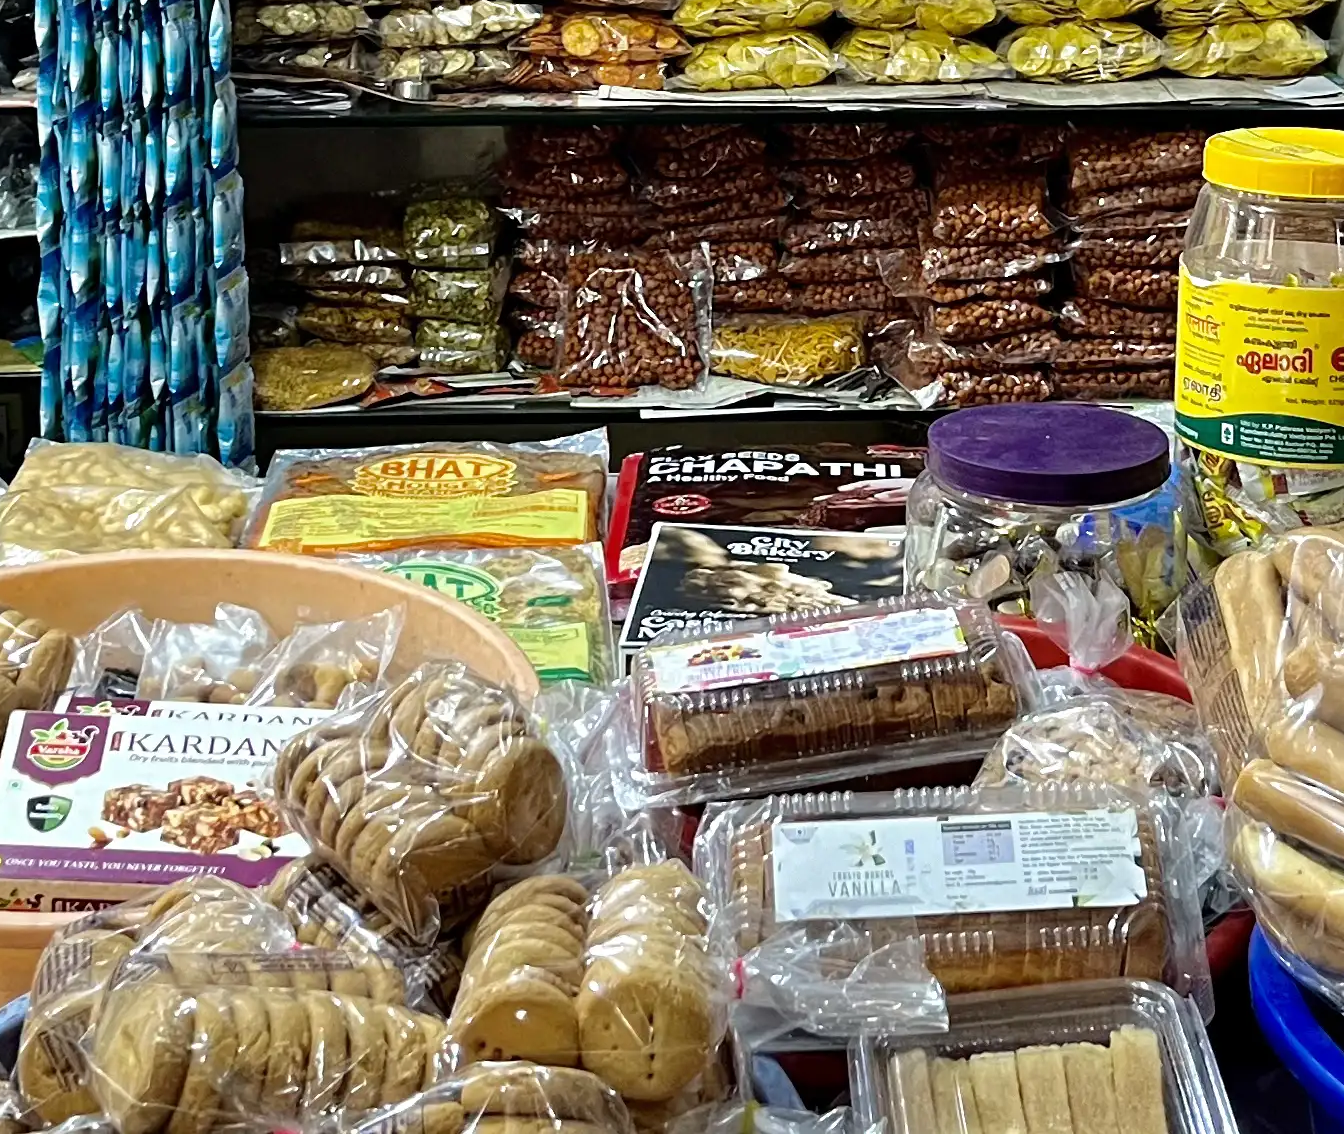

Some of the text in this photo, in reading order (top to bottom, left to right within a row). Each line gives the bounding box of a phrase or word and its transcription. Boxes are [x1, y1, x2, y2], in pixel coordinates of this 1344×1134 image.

[721, 450, 801, 462] SEEDS
[380, 458, 492, 480] BHAT
[648, 457, 902, 479] CHAPATHI
[647, 473, 790, 484] A Healthy Food
[749, 535, 811, 551] City
[727, 542, 836, 562] Bakery
[37, 744, 81, 757] Varsha
[129, 753, 148, 763] Dry
[151, 755, 179, 764] fruits
[180, 756, 225, 766] blended
[5, 857, 36, 867] ONCE
[38, 858, 61, 867] YOU
[63, 859, 99, 870] TASTE,
[101, 861, 125, 871] YOU
[126, 862, 162, 872] NEVER
[162, 864, 206, 874] FORGET
[827, 879, 903, 898] VANILLA
